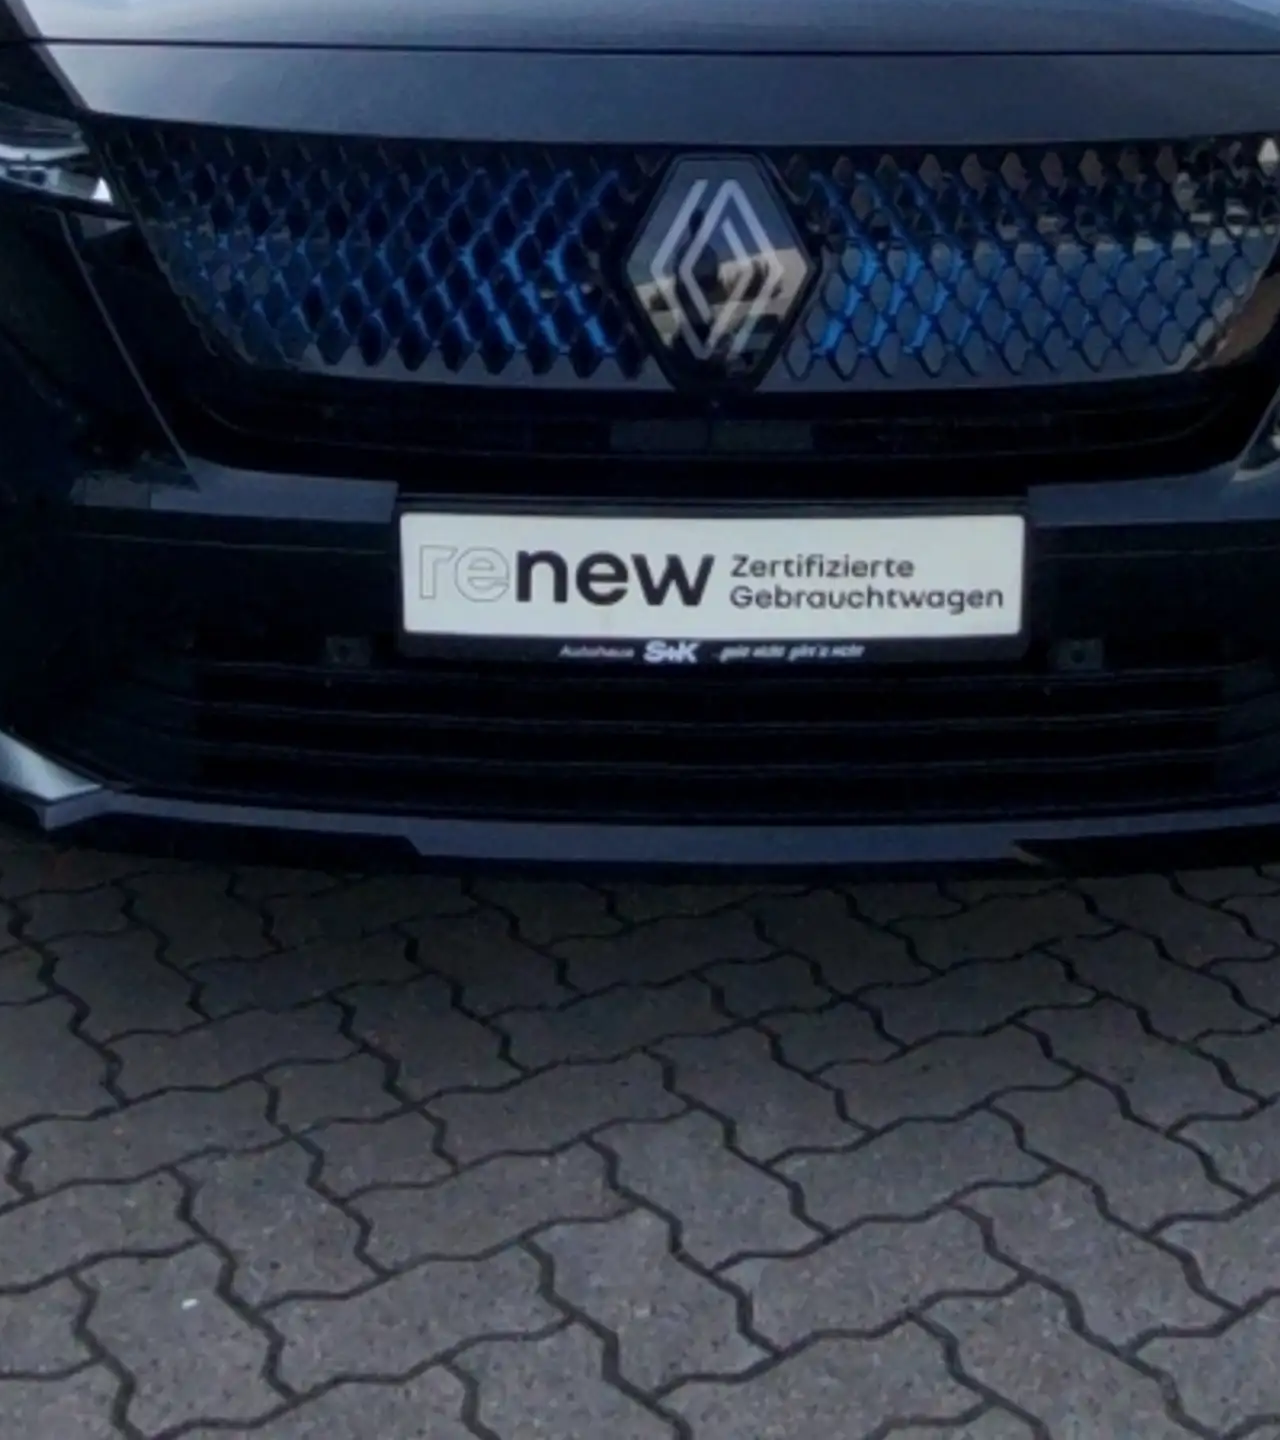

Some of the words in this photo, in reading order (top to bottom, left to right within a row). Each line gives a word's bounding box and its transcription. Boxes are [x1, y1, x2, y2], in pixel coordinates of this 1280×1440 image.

[419, 544, 715, 606] renew
[730, 553, 915, 578] Zertifizierte
[730, 584, 1003, 614] Gebrauchtwagen
